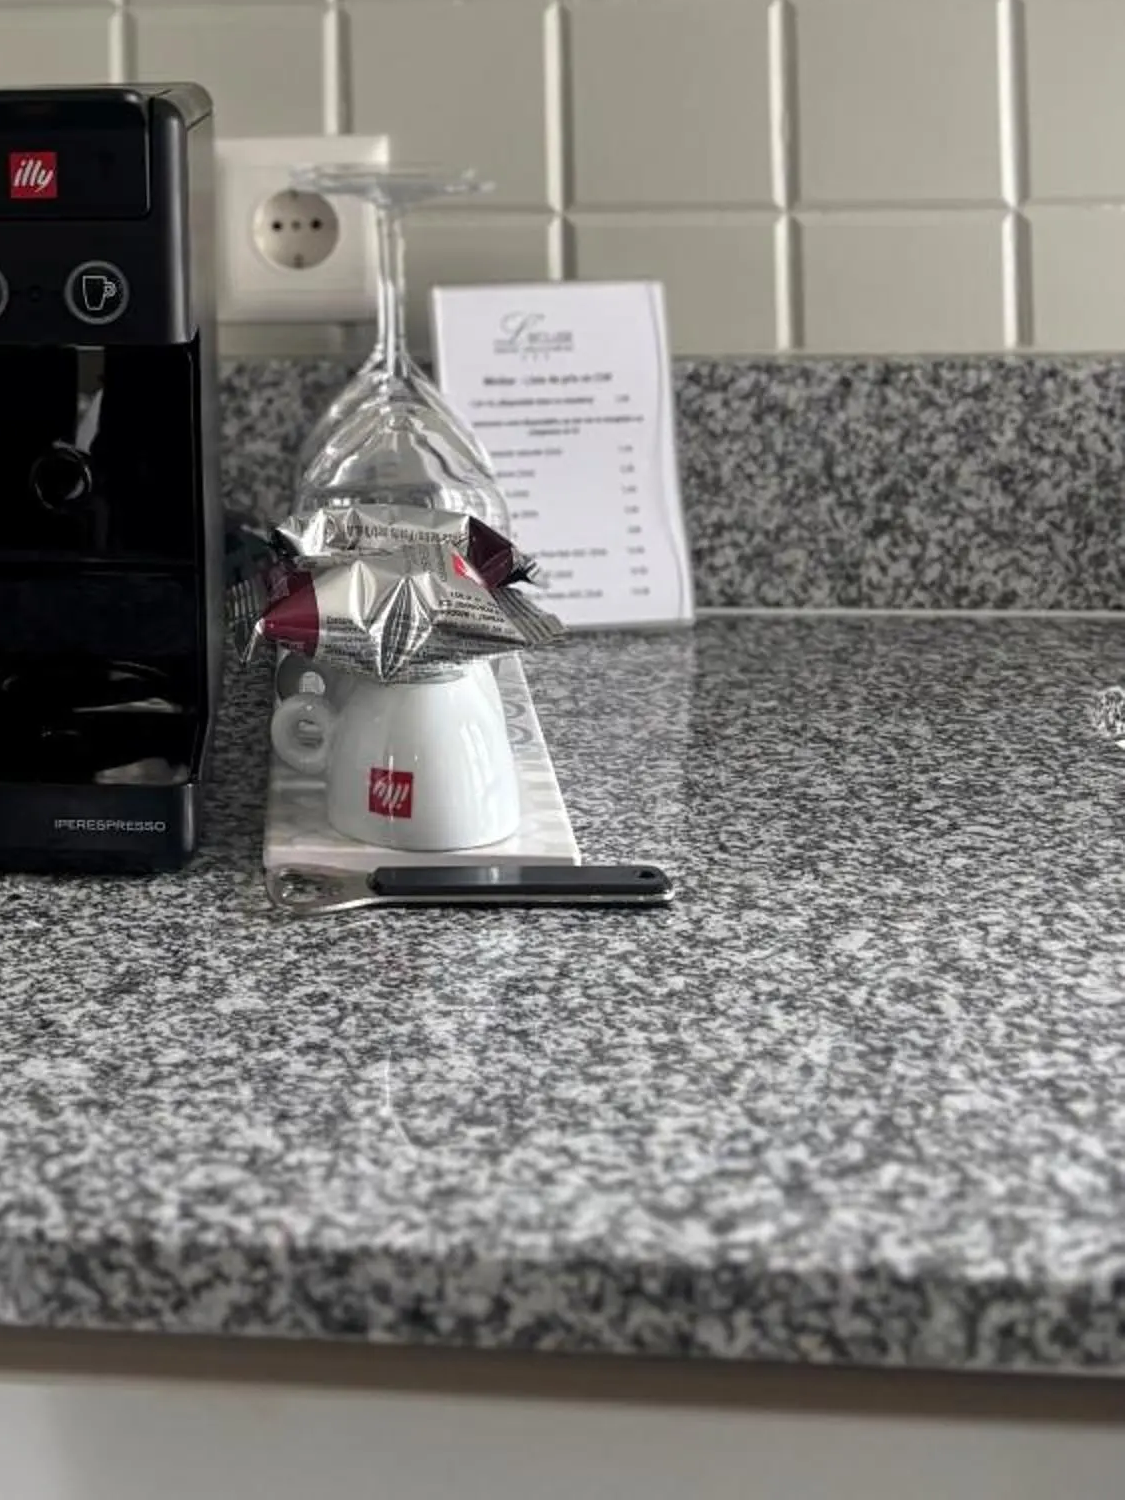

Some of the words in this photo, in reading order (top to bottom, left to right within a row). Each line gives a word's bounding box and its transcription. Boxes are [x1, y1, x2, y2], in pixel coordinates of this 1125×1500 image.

[13, 158, 55, 192] illy
[372, 776, 410, 810] illy
[53, 818, 167, 833] IPERESPRESSO
